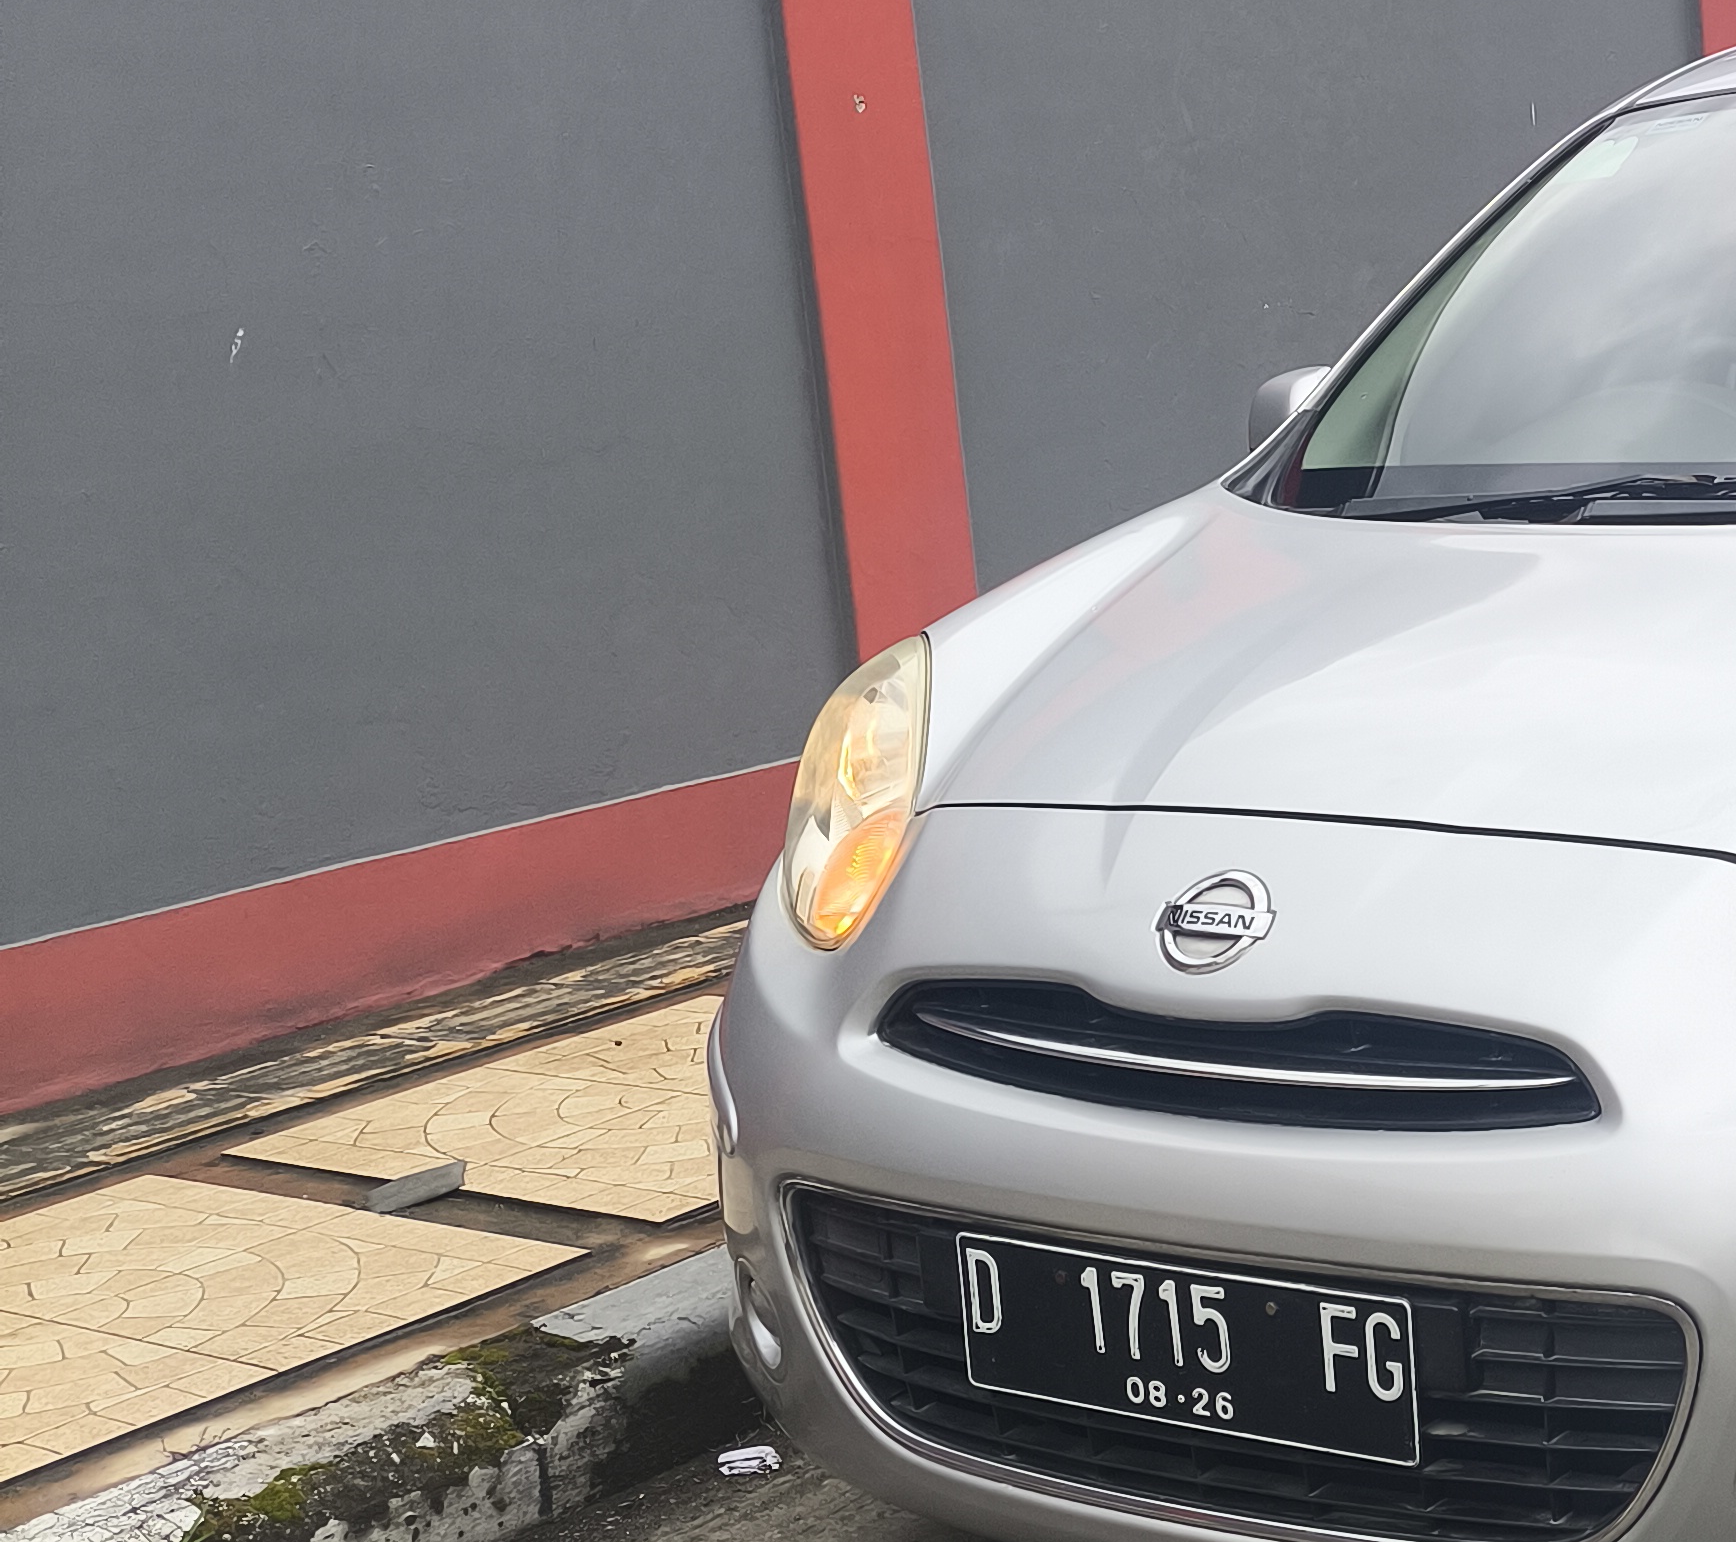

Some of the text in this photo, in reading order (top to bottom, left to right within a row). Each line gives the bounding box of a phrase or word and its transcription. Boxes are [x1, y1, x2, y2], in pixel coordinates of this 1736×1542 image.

[1168, 909, 1256, 930] NISSAN
[965, 1247, 1404, 1403] D 1715 FG
